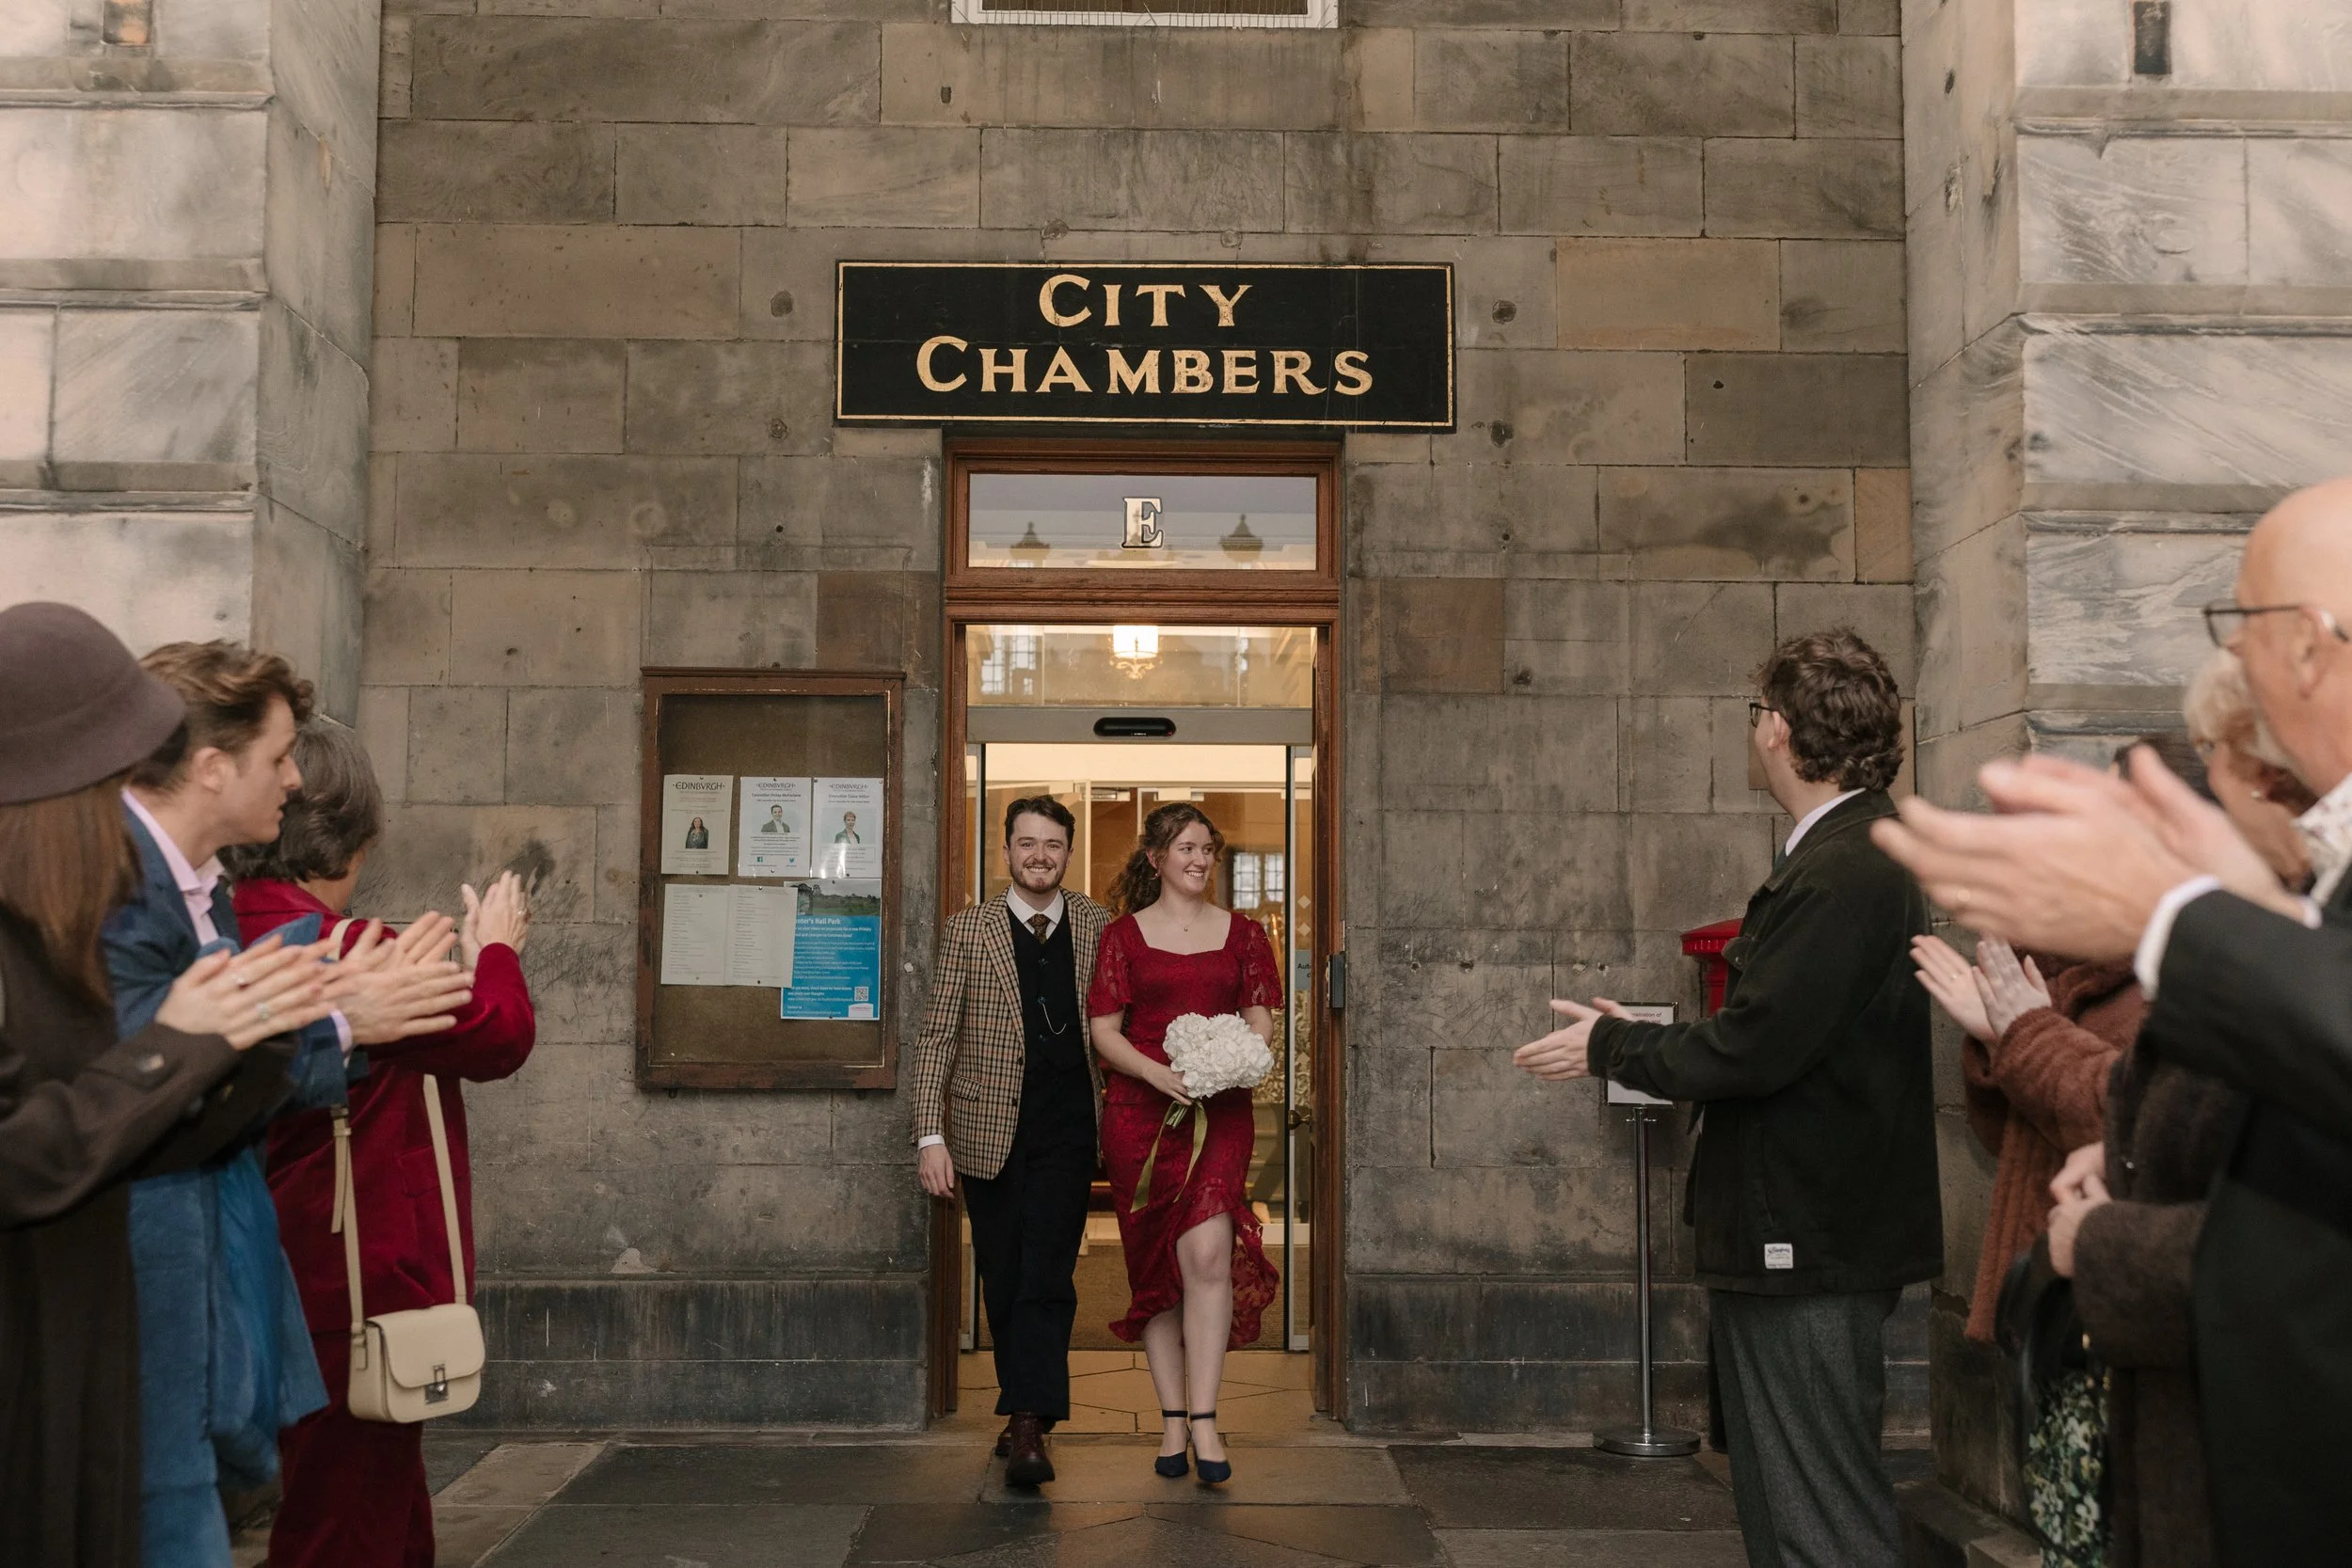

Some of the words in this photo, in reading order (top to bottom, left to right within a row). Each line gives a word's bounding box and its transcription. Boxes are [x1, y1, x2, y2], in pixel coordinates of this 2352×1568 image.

[1039, 274, 1252, 327] CITY
[916, 336, 1374, 396] CHAMBERS
[1120, 497, 1165, 549] E
